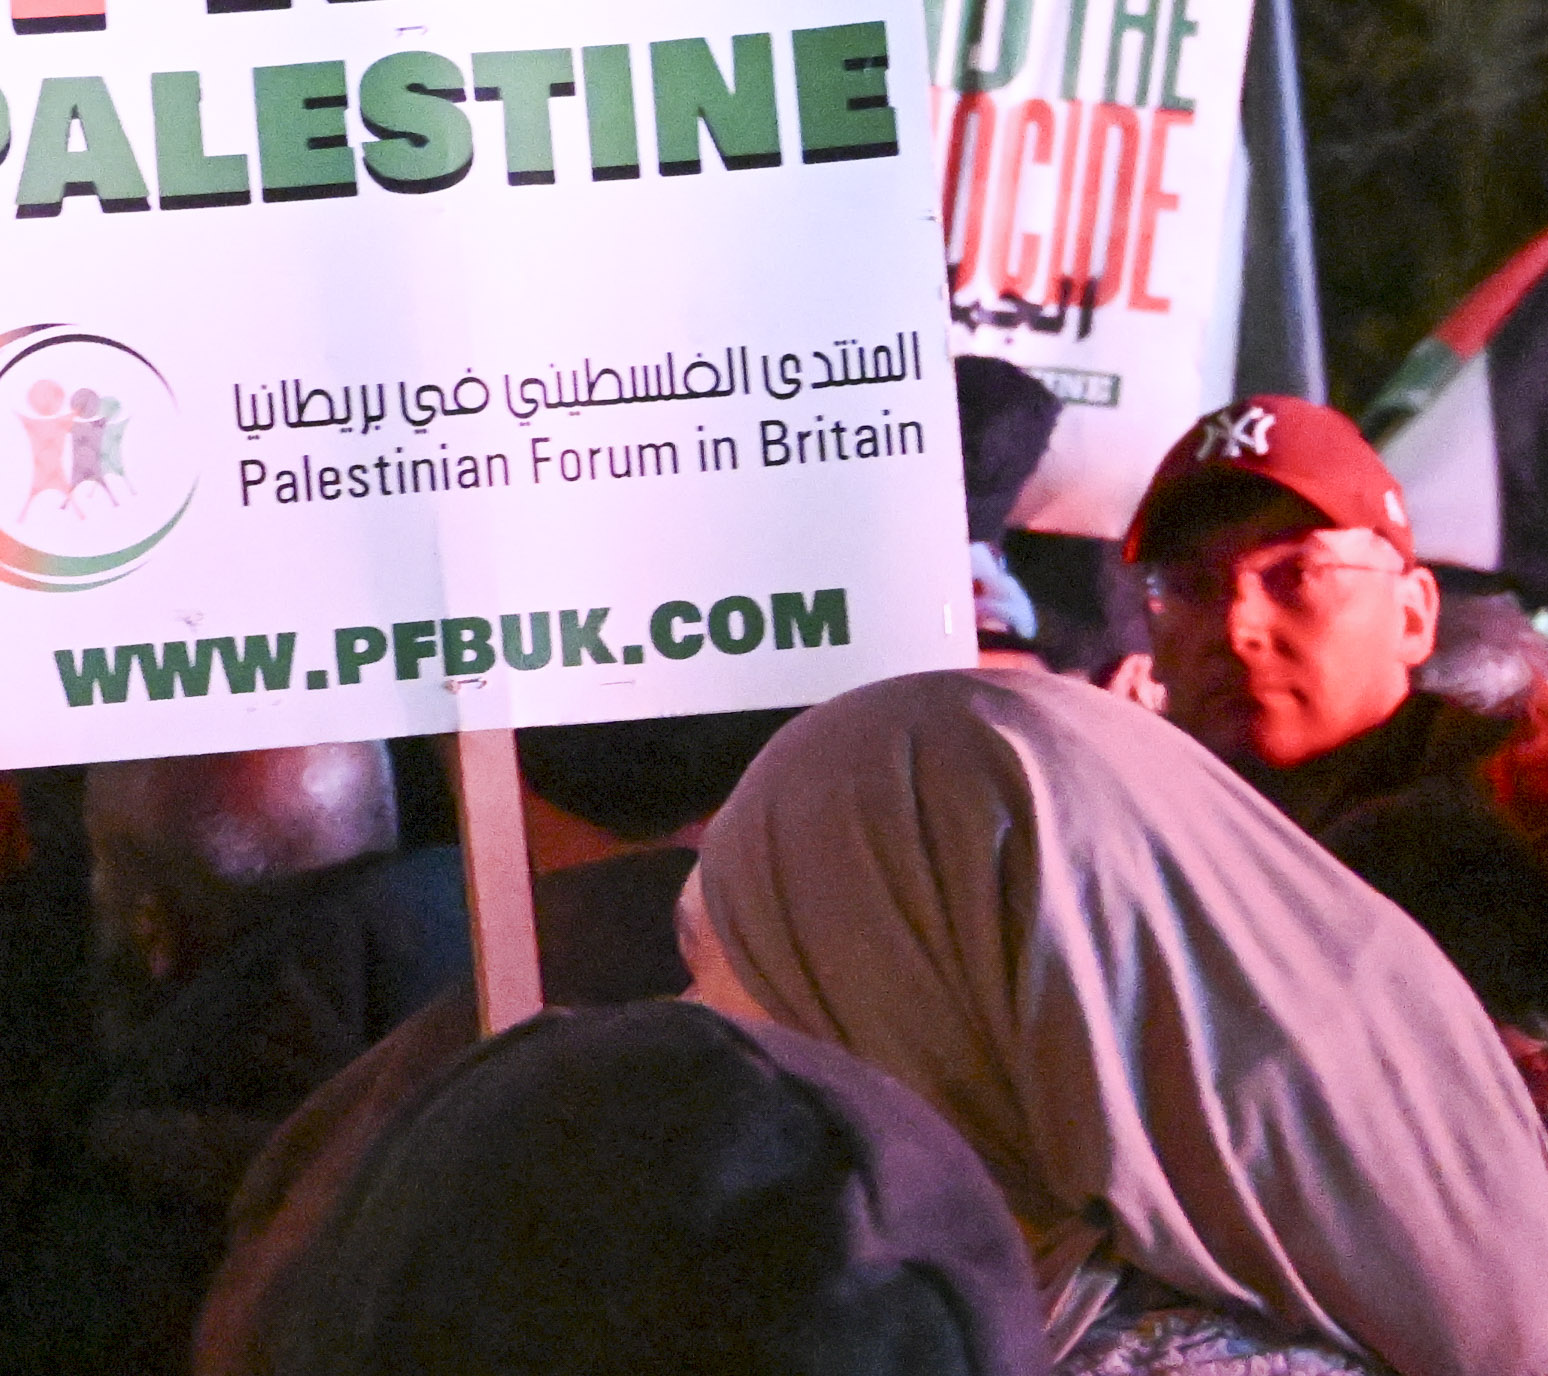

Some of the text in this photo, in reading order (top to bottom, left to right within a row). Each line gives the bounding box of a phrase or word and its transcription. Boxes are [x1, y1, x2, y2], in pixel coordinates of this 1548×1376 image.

[930, 84, 1196, 314] OCIDE
[233, 330, 921, 441] المنتدى الفلسطيني في بريطانيا
[238, 408, 925, 507] Palestinian Forum in Britain
[53, 587, 851, 708] WWW.PFBUK.COM
